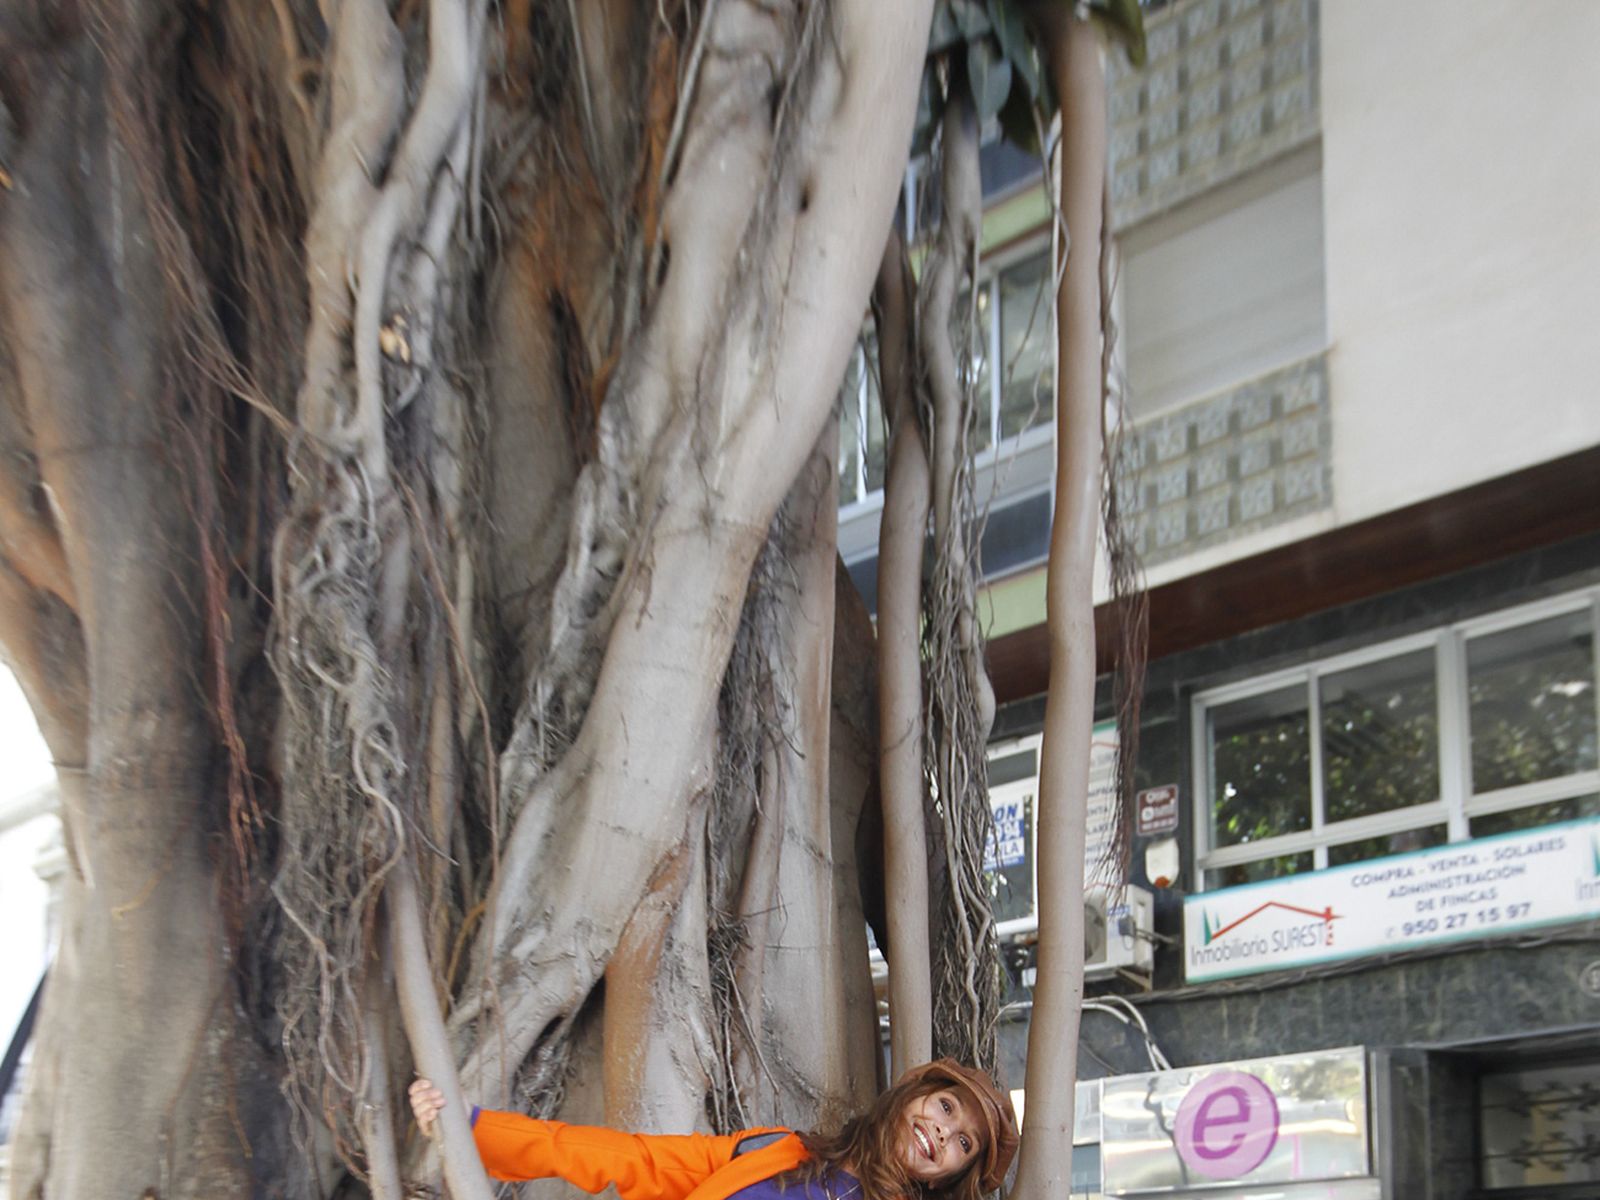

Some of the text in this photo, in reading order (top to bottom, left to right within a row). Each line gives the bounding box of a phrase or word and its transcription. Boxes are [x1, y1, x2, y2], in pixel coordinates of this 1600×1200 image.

[1351, 866, 1415, 888] COMPRA
[1429, 855, 1480, 874] VENTA
[1493, 836, 1567, 862] SOLARES
[1401, 902, 1532, 936] 950 27 15 97
[1415, 887, 1499, 913] DE FINCAS
[1192, 1086, 1251, 1160] e
